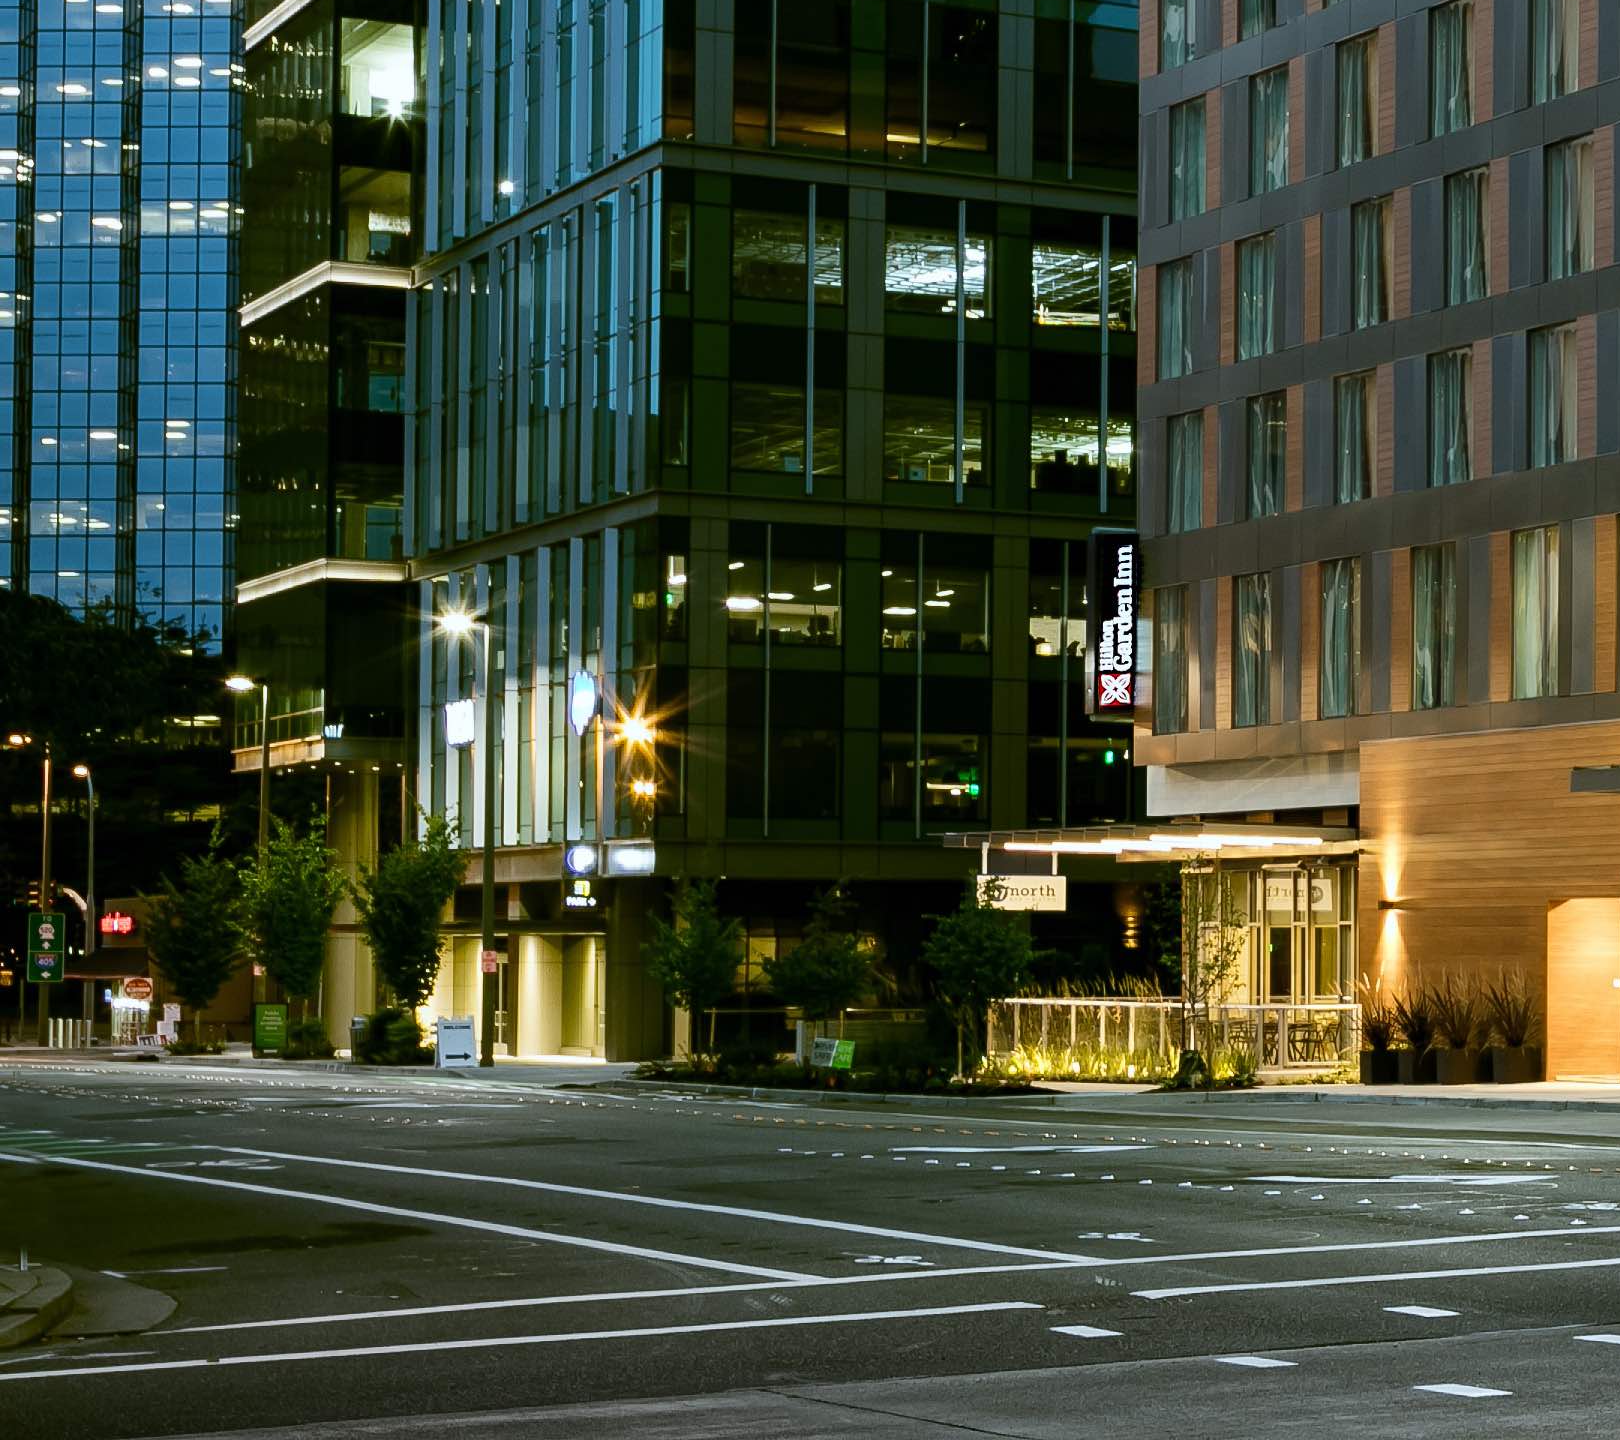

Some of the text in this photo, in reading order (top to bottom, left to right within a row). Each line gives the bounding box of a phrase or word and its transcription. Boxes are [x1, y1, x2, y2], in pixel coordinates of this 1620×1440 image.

[1113, 544, 1132, 672] Garden Inn
[1100, 619, 1114, 671] Hilton
[1010, 884, 1056, 897] north
[39, 958, 55, 967] 405
